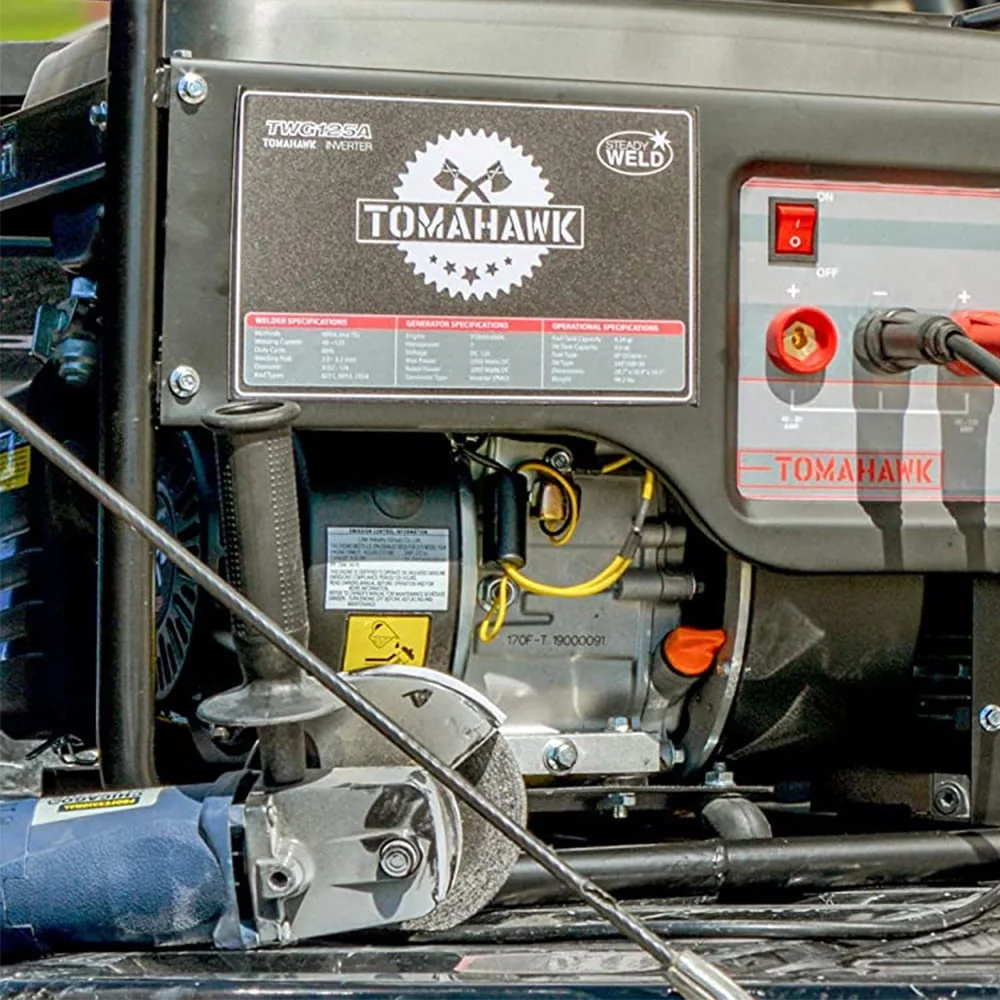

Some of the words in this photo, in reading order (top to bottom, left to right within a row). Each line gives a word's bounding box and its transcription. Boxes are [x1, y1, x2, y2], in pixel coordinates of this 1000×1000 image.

[265, 119, 372, 139] TWG125A
[262, 138, 317, 149] TOMAHAWK
[325, 140, 373, 151] INVERTER
[605, 140, 649, 151] STEADY
[606, 149, 664, 168] WELD
[816, 192, 834, 202] ON
[364, 204, 576, 242] TOMAHAWK
[816, 266, 840, 278] OFF
[775, 456, 932, 483] TOMAHAWK
